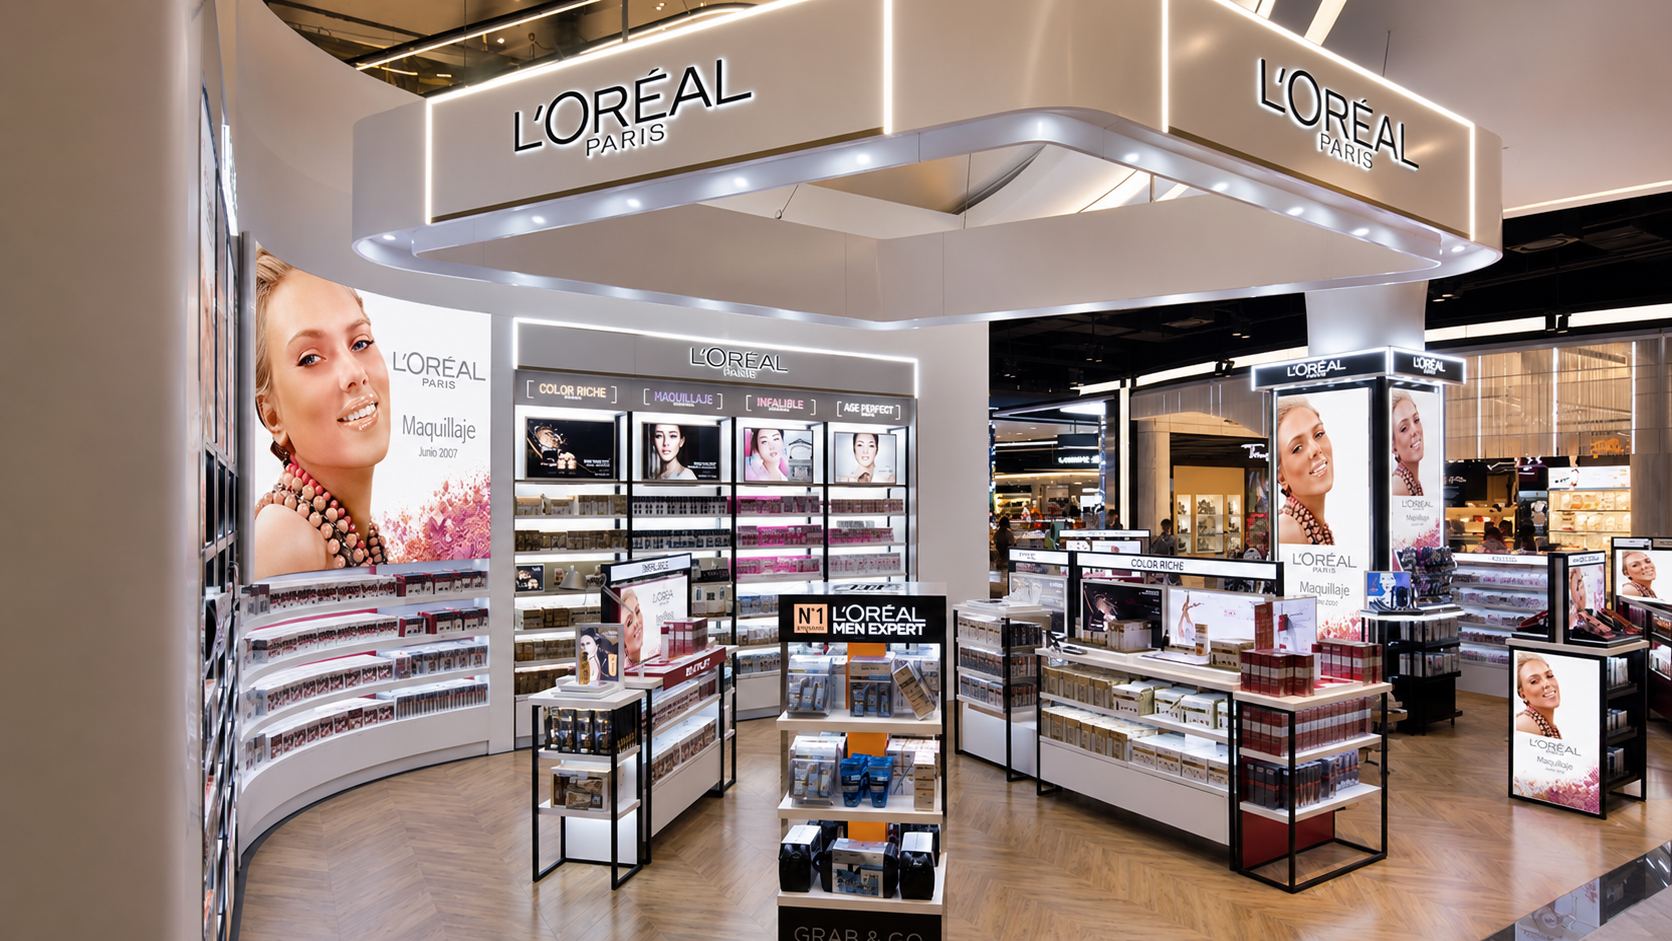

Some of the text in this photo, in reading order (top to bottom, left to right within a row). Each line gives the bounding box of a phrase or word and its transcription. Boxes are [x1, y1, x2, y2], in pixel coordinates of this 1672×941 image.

[513, 58, 752, 153] L'ORÉAL
[1260, 58, 1420, 170] L'ORÉAL
[586, 123, 665, 157] PARIS
[1320, 132, 1374, 169] PARIS
[393, 351, 486, 381] L'ORÉAL
[690, 346, 789, 374] L'ORÉAL
[422, 377, 456, 390] PARIS
[539, 383, 607, 399] COLOR RICHE
[844, 402, 860, 413] AGE
[402, 414, 476, 444] Maquillaje
[418, 446, 458, 458] Junio 2007
[1131, 558, 1158, 570] COLOR
[1293, 551, 1357, 569] L'ORÉAL
[1299, 581, 1350, 599] Maquillaje
[832, 604, 926, 623] L'ORÉAL
[833, 622, 865, 635] MEN
[868, 622, 926, 636] EXPERT
